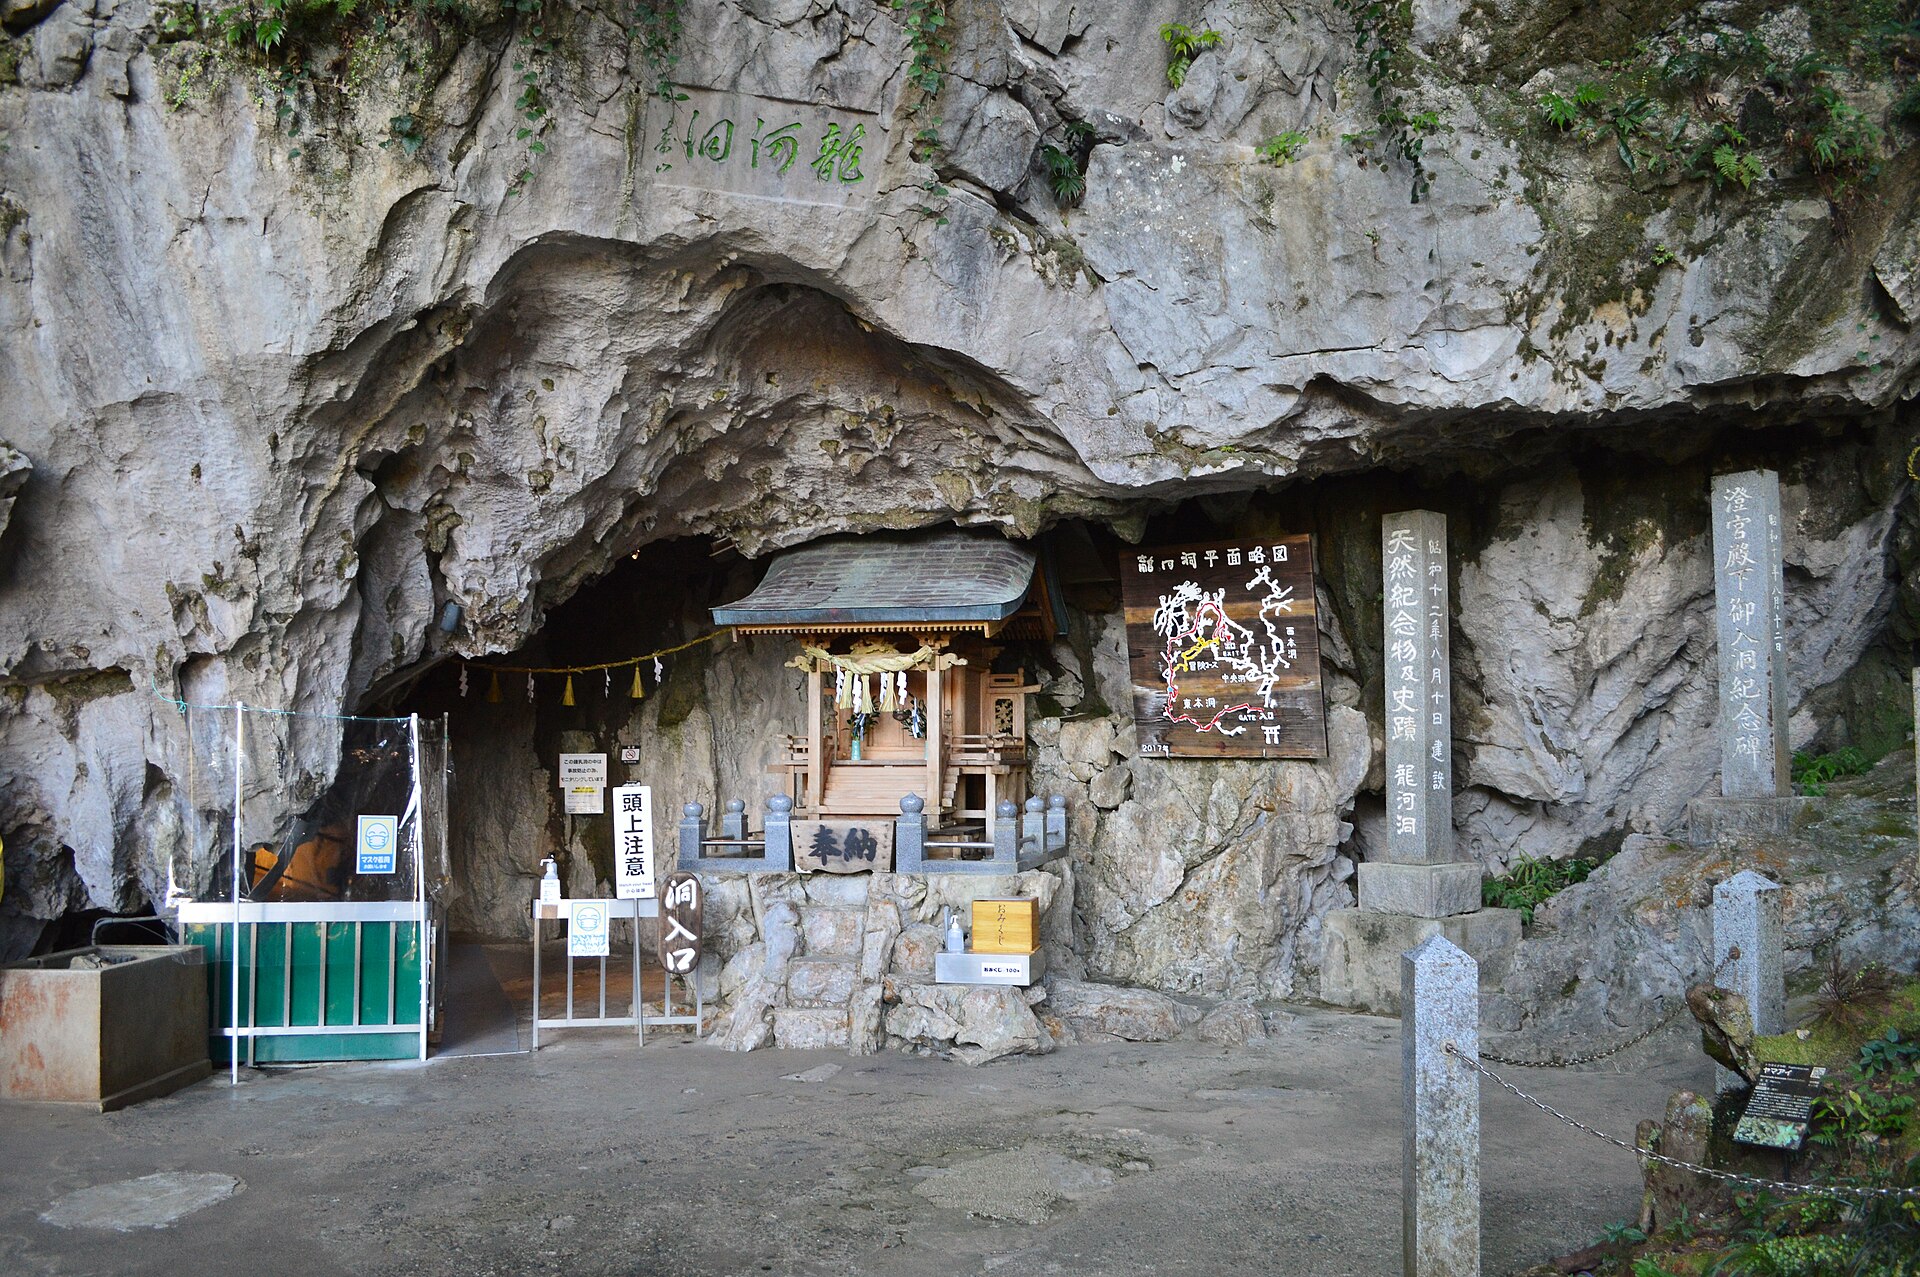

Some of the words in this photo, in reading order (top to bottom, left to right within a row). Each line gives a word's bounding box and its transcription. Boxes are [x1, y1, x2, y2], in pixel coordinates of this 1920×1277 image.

[1768, 513, 1783, 652] 昭和十年八月十二日
[1183, 697, 1216, 709] 東本洞
[1394, 763, 1418, 836] 龍河洞
[622, 793, 645, 876] 頭上注意
[807, 824, 879, 867] 奉納
[664, 878, 698, 972] 洞入口
[997, 904, 1006, 946] おみくじ
[1763, 1067, 1792, 1076] ヤマアイ
